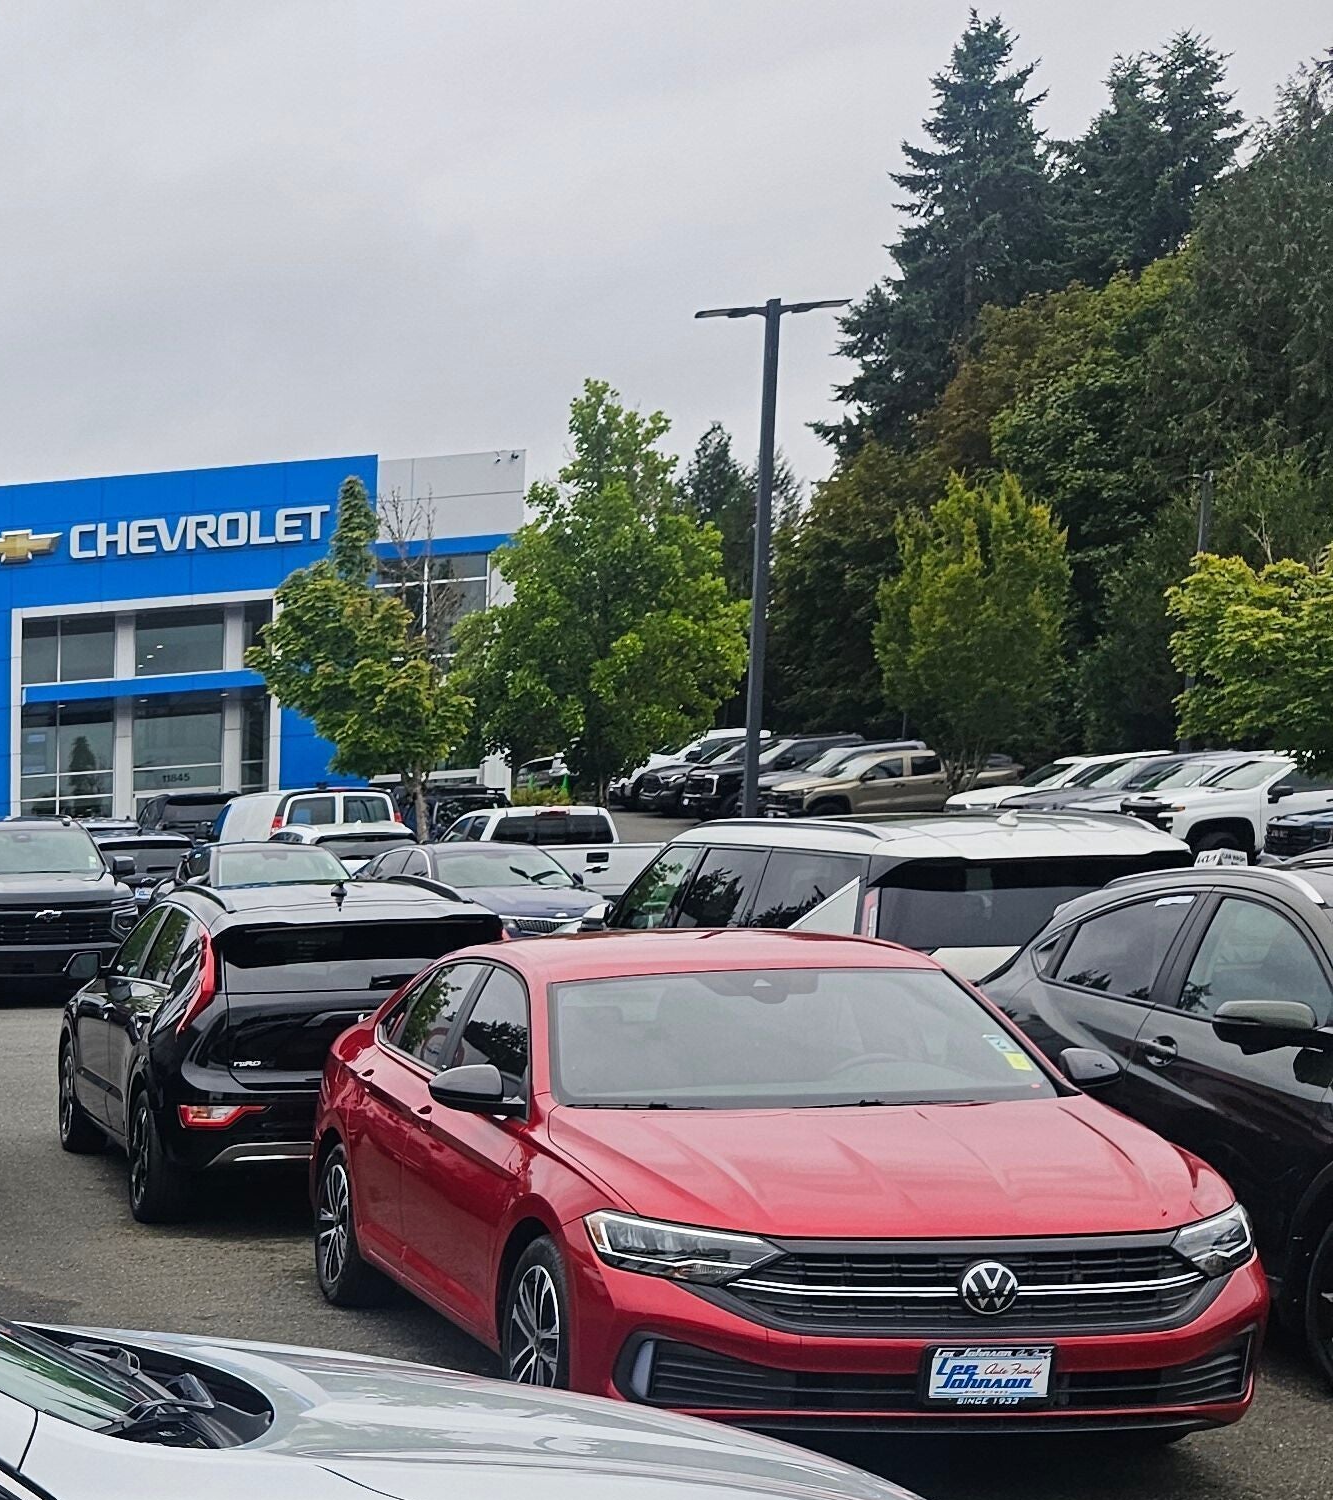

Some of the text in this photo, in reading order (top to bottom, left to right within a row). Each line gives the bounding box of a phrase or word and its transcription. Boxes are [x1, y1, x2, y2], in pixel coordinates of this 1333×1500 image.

[69, 504, 331, 560] CHEVROLET
[936, 1358, 980, 1375] Lee
[985, 1363, 1007, 1375] Auto
[936, 1374, 1034, 1389] Johnson
[956, 1397, 1020, 1405] SINCE 1933
